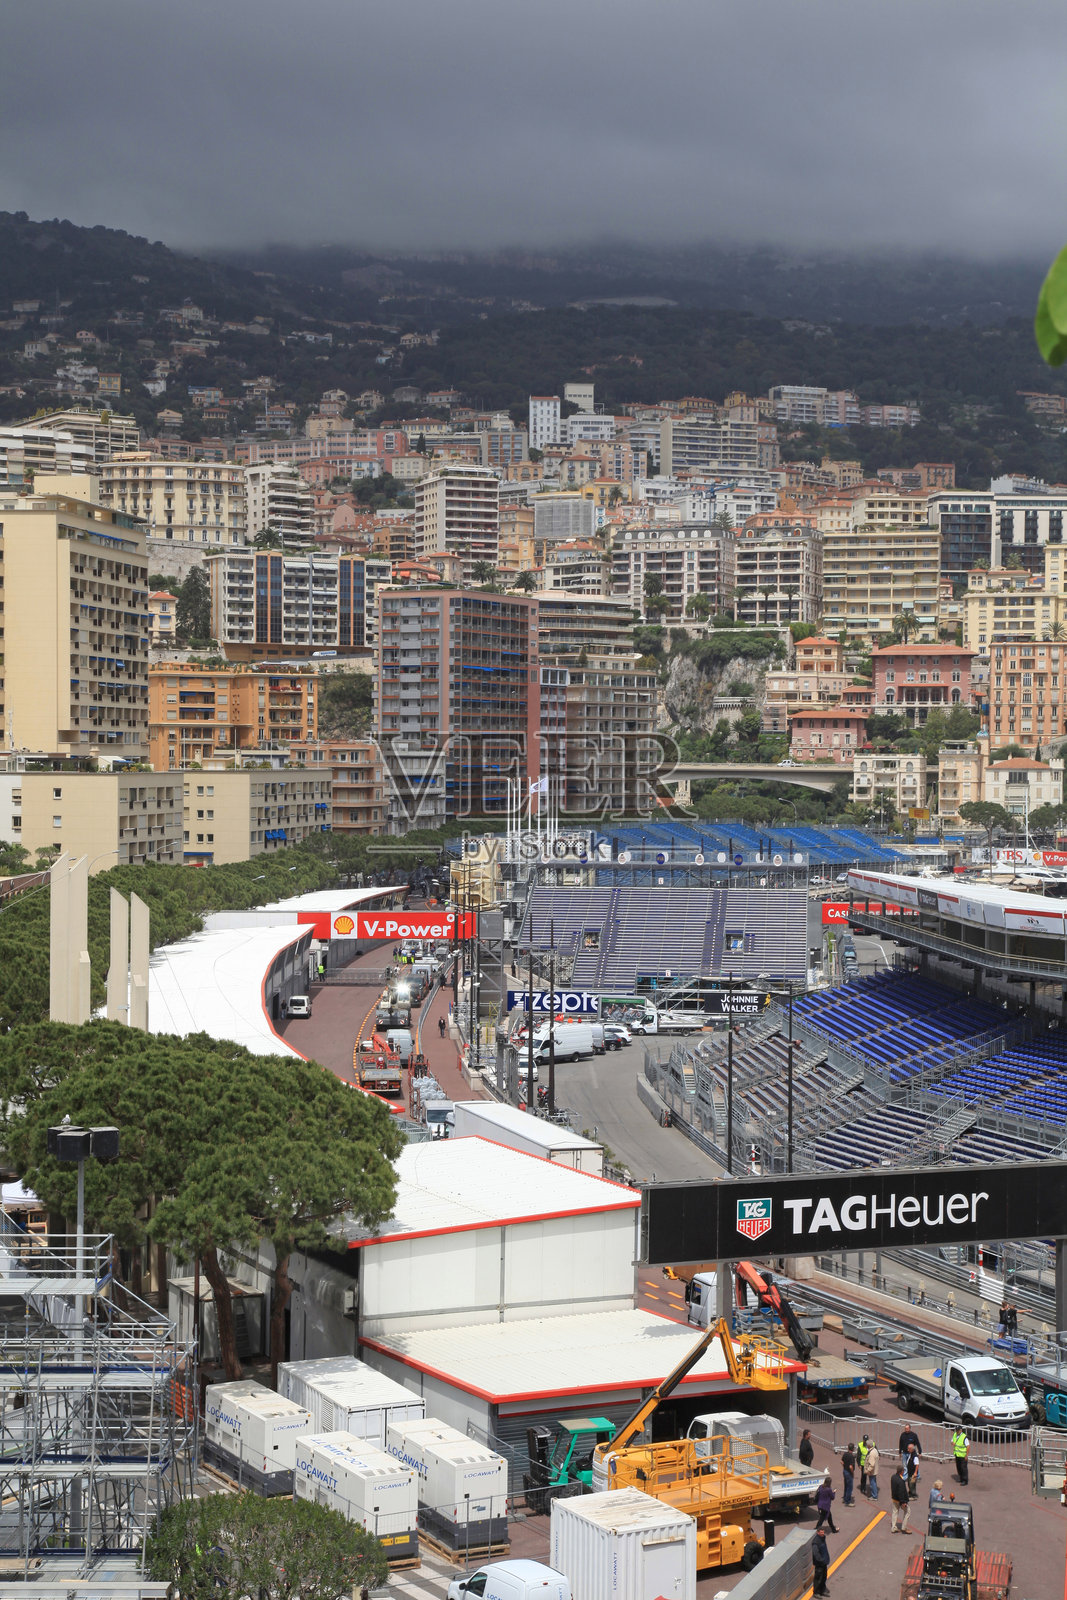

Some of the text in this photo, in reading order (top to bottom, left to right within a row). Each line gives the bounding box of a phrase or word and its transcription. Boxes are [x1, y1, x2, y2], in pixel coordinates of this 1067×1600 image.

[997, 850, 1023, 860] UBS
[363, 920, 451, 937] V-Power
[720, 994, 759, 1003] JOHNNIE
[721, 1002, 759, 1012] WALKER
[743, 1201, 766, 1218] TAG
[739, 1219, 769, 1237] HEUER
[206, 1405, 242, 1431] LOCAWATT
[273, 1423, 307, 1432] LOCAWATT
[387, 1444, 429, 1475] LOCAWATT
[296, 1458, 339, 1489] LOCAWATT
[463, 1470, 499, 1479] LOCAWATT
[373, 1482, 409, 1491] LOCAWATT
